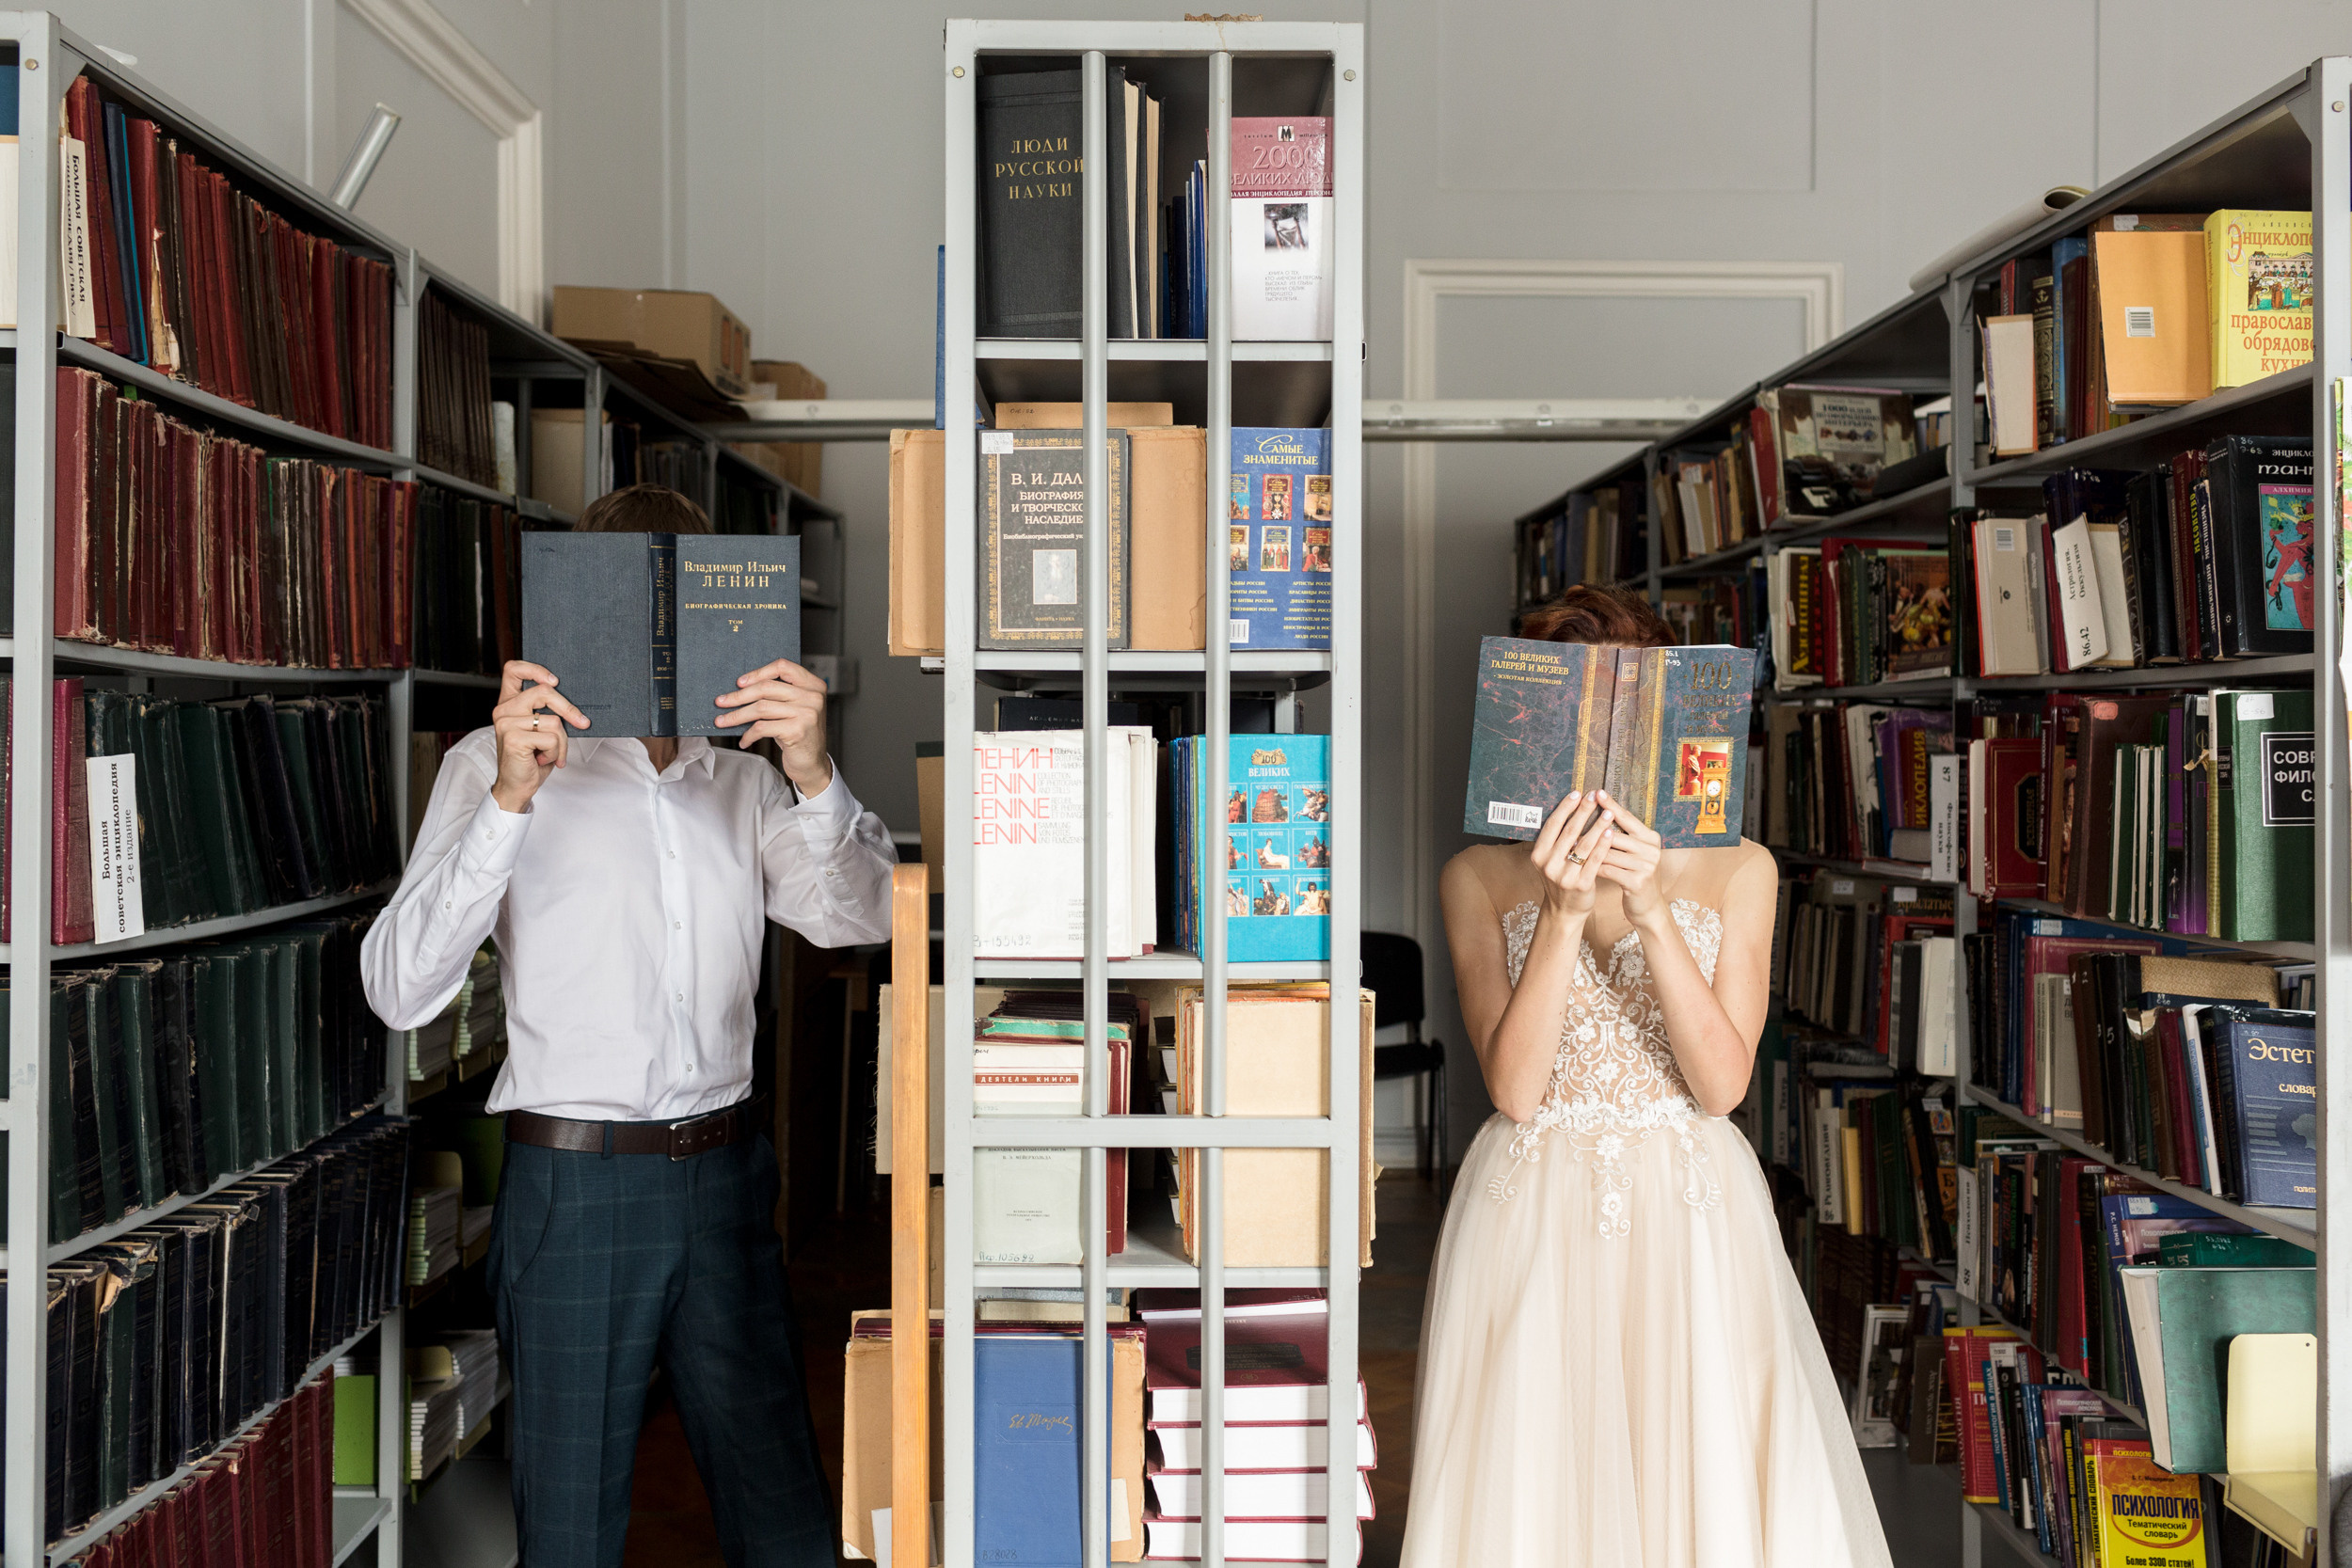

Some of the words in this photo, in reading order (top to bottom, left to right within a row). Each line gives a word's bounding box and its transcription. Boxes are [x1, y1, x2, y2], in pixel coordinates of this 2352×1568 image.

[1011, 137, 1068, 154] ЛЮДИ
[1252, 145, 1322, 169] 2000
[994, 156, 1083, 178] РУССКОЙ
[1295, 172, 1332, 185] ЛЮД
[1009, 182, 1073, 199] НАУКИ
[1243, 454, 1319, 466] ЗНАМЕНИТЫЕ
[1011, 473, 1026, 486] В.
[1030, 473, 1046, 486] И.
[1019, 490, 1084, 501] БИОГРАФИЯ
[1011, 503, 1020, 513] И
[1025, 515, 1084, 526] НАСЛЕДИЕ
[2189, 492, 2201, 555] МАСОНСТВО
[656, 557, 665, 588] Ильич
[683, 561, 744, 575] Владимир
[747, 561, 787, 573] Ильич
[2073, 543, 2087, 599] Оккультизм
[702, 576, 771, 588] ЛЕНИН
[656, 591, 666, 637] Владимир
[2080, 626, 2092, 657] 86.42
[1503, 651, 1518, 660] 100
[1519, 653, 1560, 665] ВЕЛИКИХ
[1491, 660, 1526, 672] ГАЛЕРЕЙ
[1528, 664, 1535, 673] И
[1536, 665, 1569, 676] МУЗЕЕВ
[1691, 662, 1732, 690] 100
[1497, 673, 1525, 682] ЗОЛОТАЯ
[1525, 676, 1563, 686] КОЛЛЕКЦИЯ
[1261, 754, 1277, 764] 100
[1248, 768, 1291, 777] ВЕЛИКИХ
[1943, 767, 1951, 783] 87
[110, 763, 122, 861] энциклопедия
[124, 809, 135, 860] издание
[1946, 801, 1954, 875] Философские
[101, 820, 111, 880] Большая
[126, 863, 135, 885] 2-е
[116, 864, 126, 934] советская
[2111, 1224, 2122, 1246] НЕМОВ
[1963, 1268, 1972, 1287] 88
[2086, 1459, 2097, 1495] СЛОВАРЬ
[2111, 1494, 2201, 1519] ПСИХОЛОГИЯ
[2090, 1496, 2101, 1553] ТЕМАТИЧЕСКИЙ
[2127, 1518, 2188, 1530] Тематический
[2144, 1530, 2179, 1541] словарь
[2125, 1555, 2148, 1567] Более
[2148, 1557, 2167, 1567] 3300
[2168, 1558, 2195, 1568] статей!
